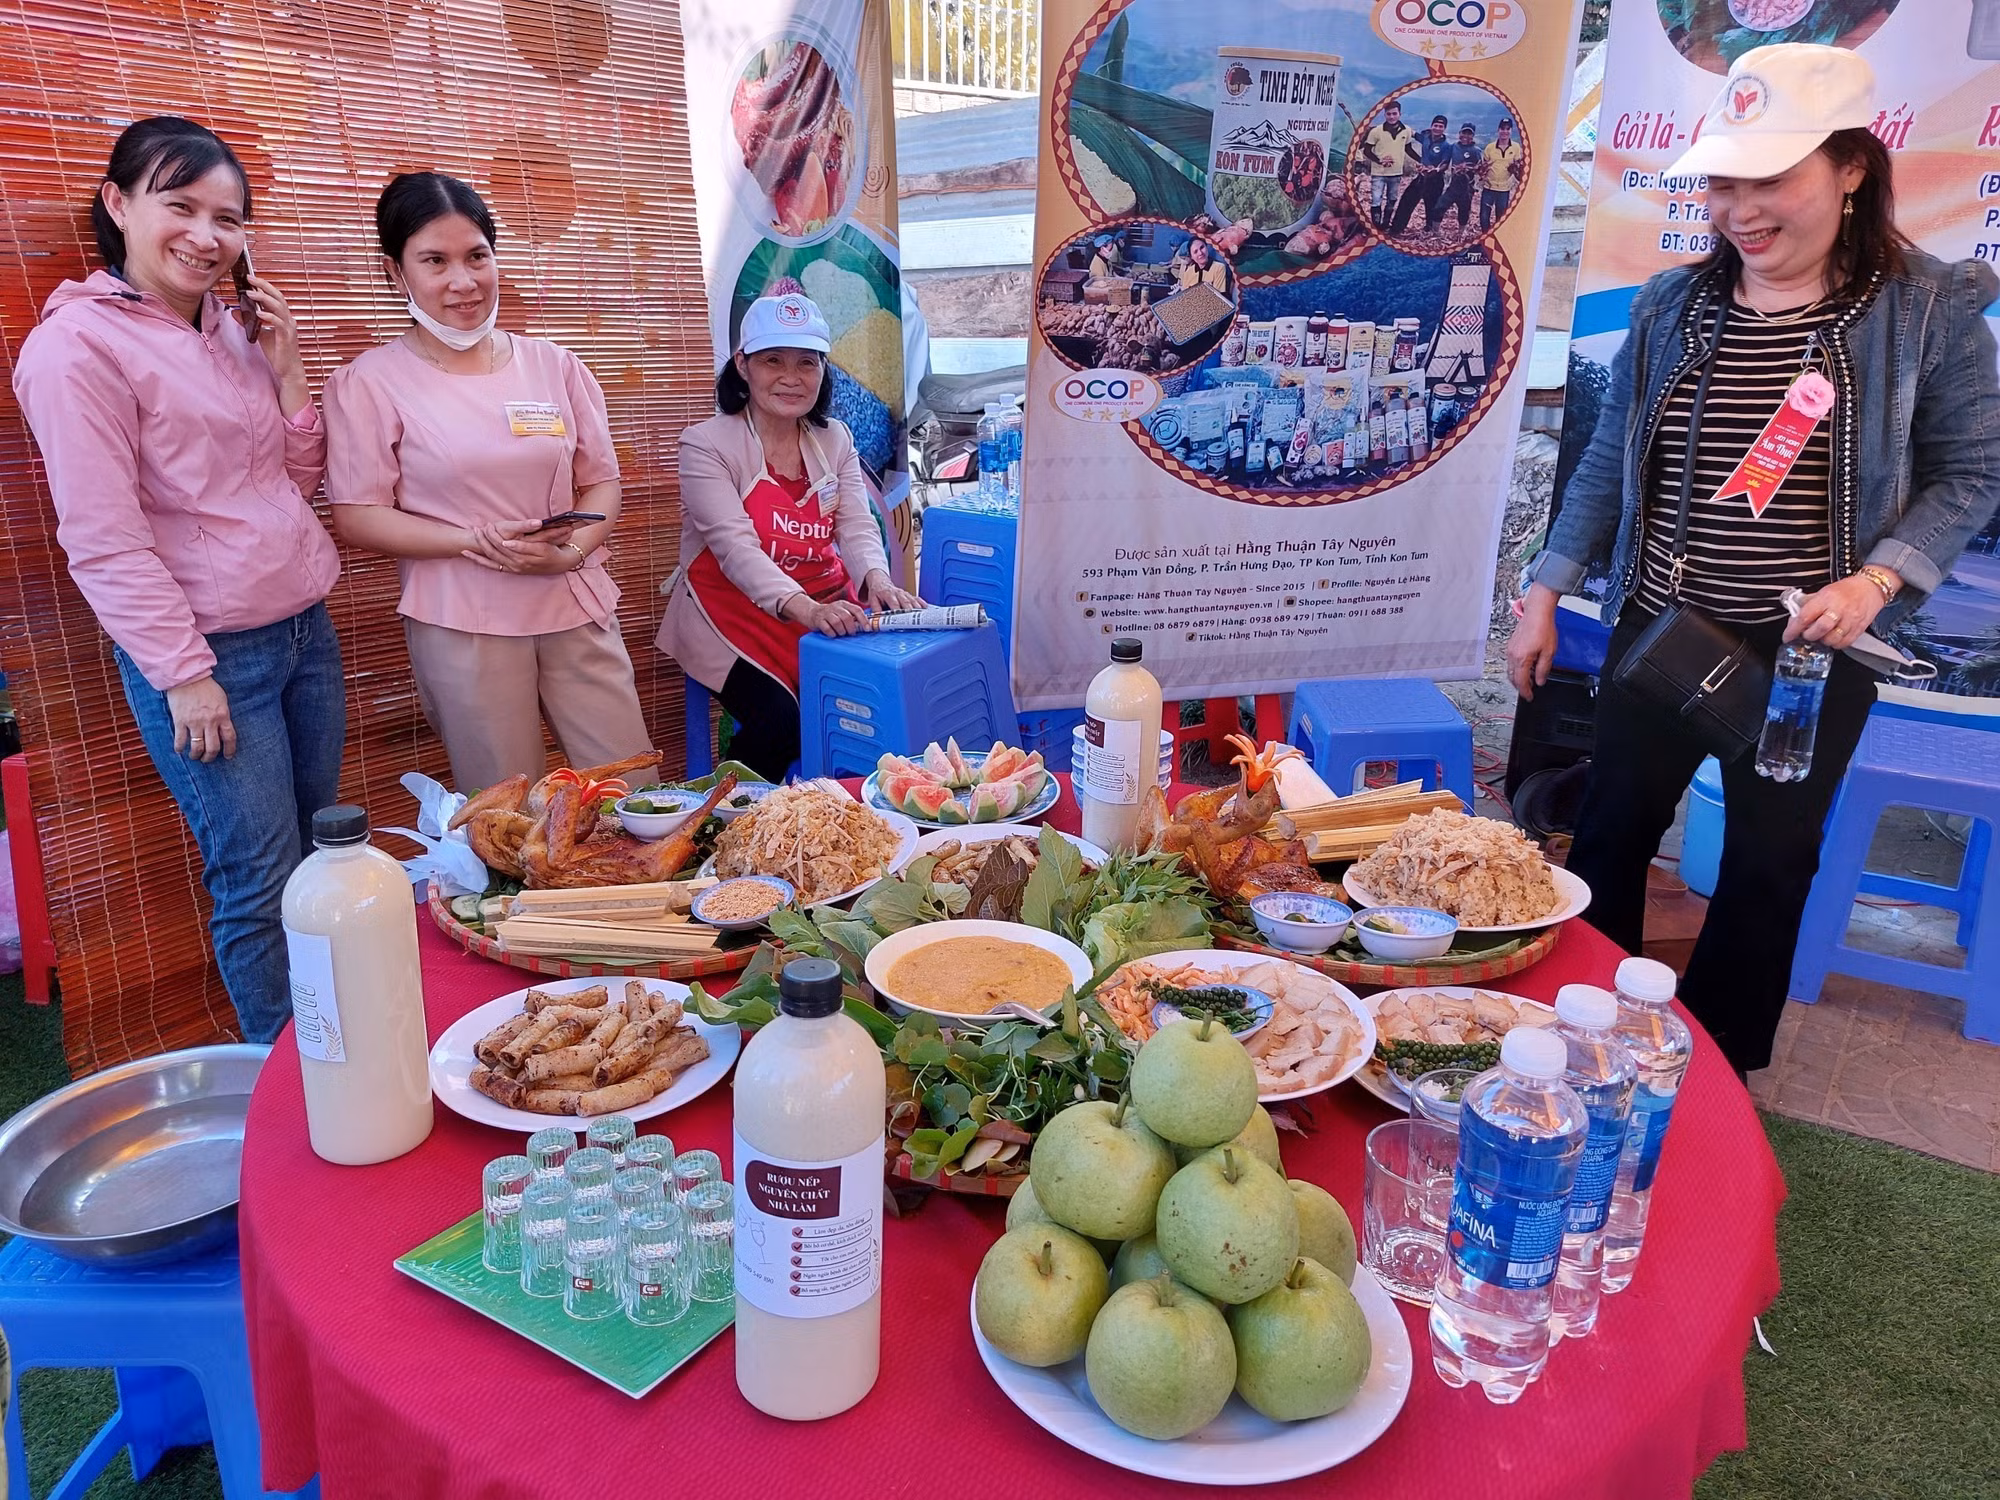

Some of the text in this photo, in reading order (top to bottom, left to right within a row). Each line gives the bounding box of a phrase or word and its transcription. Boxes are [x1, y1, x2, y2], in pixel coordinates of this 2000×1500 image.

[1396, 0, 1511, 29] OCOP
[1260, 70, 1289, 103] TINH
[1613, 111, 1650, 149] Gỏi
[1650, 110, 1674, 149] lá
[1216, 151, 1275, 174] KON TUM
[1668, 204, 1678, 220] P.
[1662, 234, 1718, 251] ĐT: 036
[1065, 380, 1144, 399] OCOP
[773, 511, 833, 539] Neptu
[1116, 536, 1396, 561] Được sản xuất tại Hằng Thuận Tây Nguyên
[1082, 569, 1103, 578] 593
[1107, 567, 1138, 579] Phạm
[1142, 566, 1161, 576] Văn
[1166, 562, 1197, 576] Đồng,
[1201, 563, 1209, 572] P.
[1213, 561, 1237, 572] Trần
[1240, 560, 1268, 572] Hưng
[1272, 559, 1295, 570] Đạo,
[1300, 558, 1312, 567] TP
[1316, 557, 1334, 567] Kon
[1339, 556, 1362, 566] Tum,
[1390, 552, 1407, 562] Kon
[1411, 552, 1428, 560] Tum
[1090, 593, 1134, 602] Fanpage:
[1164, 589, 1192, 598] Thuận
[1195, 588, 1211, 597] Tây
[1256, 584, 1280, 593] Since
[1283, 582, 1305, 591] 2015
[1331, 580, 1362, 589] Profile:
[1101, 591, 1421, 618] Website: www.hangthuantaynguyen.vn Shopee: hangthuantaynguyen
[1116, 624, 1151, 632] Hotline:
[1154, 622, 1164, 630] 08
[1168, 621, 1190, 629] 6879
[1193, 620, 1214, 628] 6879
[1250, 616, 1272, 624] 0938
[1274, 614, 1290, 622] 689
[1293, 613, 1309, 621] 479
[1317, 611, 1346, 620] Thuận:
[1349, 609, 1368, 618] 0911
[1371, 608, 1387, 616] 688
[1390, 606, 1404, 614] 388
[1199, 633, 1226, 642] Tiktok:
[1253, 630, 1278, 638] Thuận
[1281, 628, 1295, 636] Tây
[1298, 626, 1328, 636] Nguyên
[758, 1182, 831, 1199] NGUYÊN CHẤT
[767, 1172, 820, 1186] RƯỢU NẾP
[768, 1199, 816, 1212] NHÀ LÀM
[1452, 1201, 1496, 1248] UAFINA
